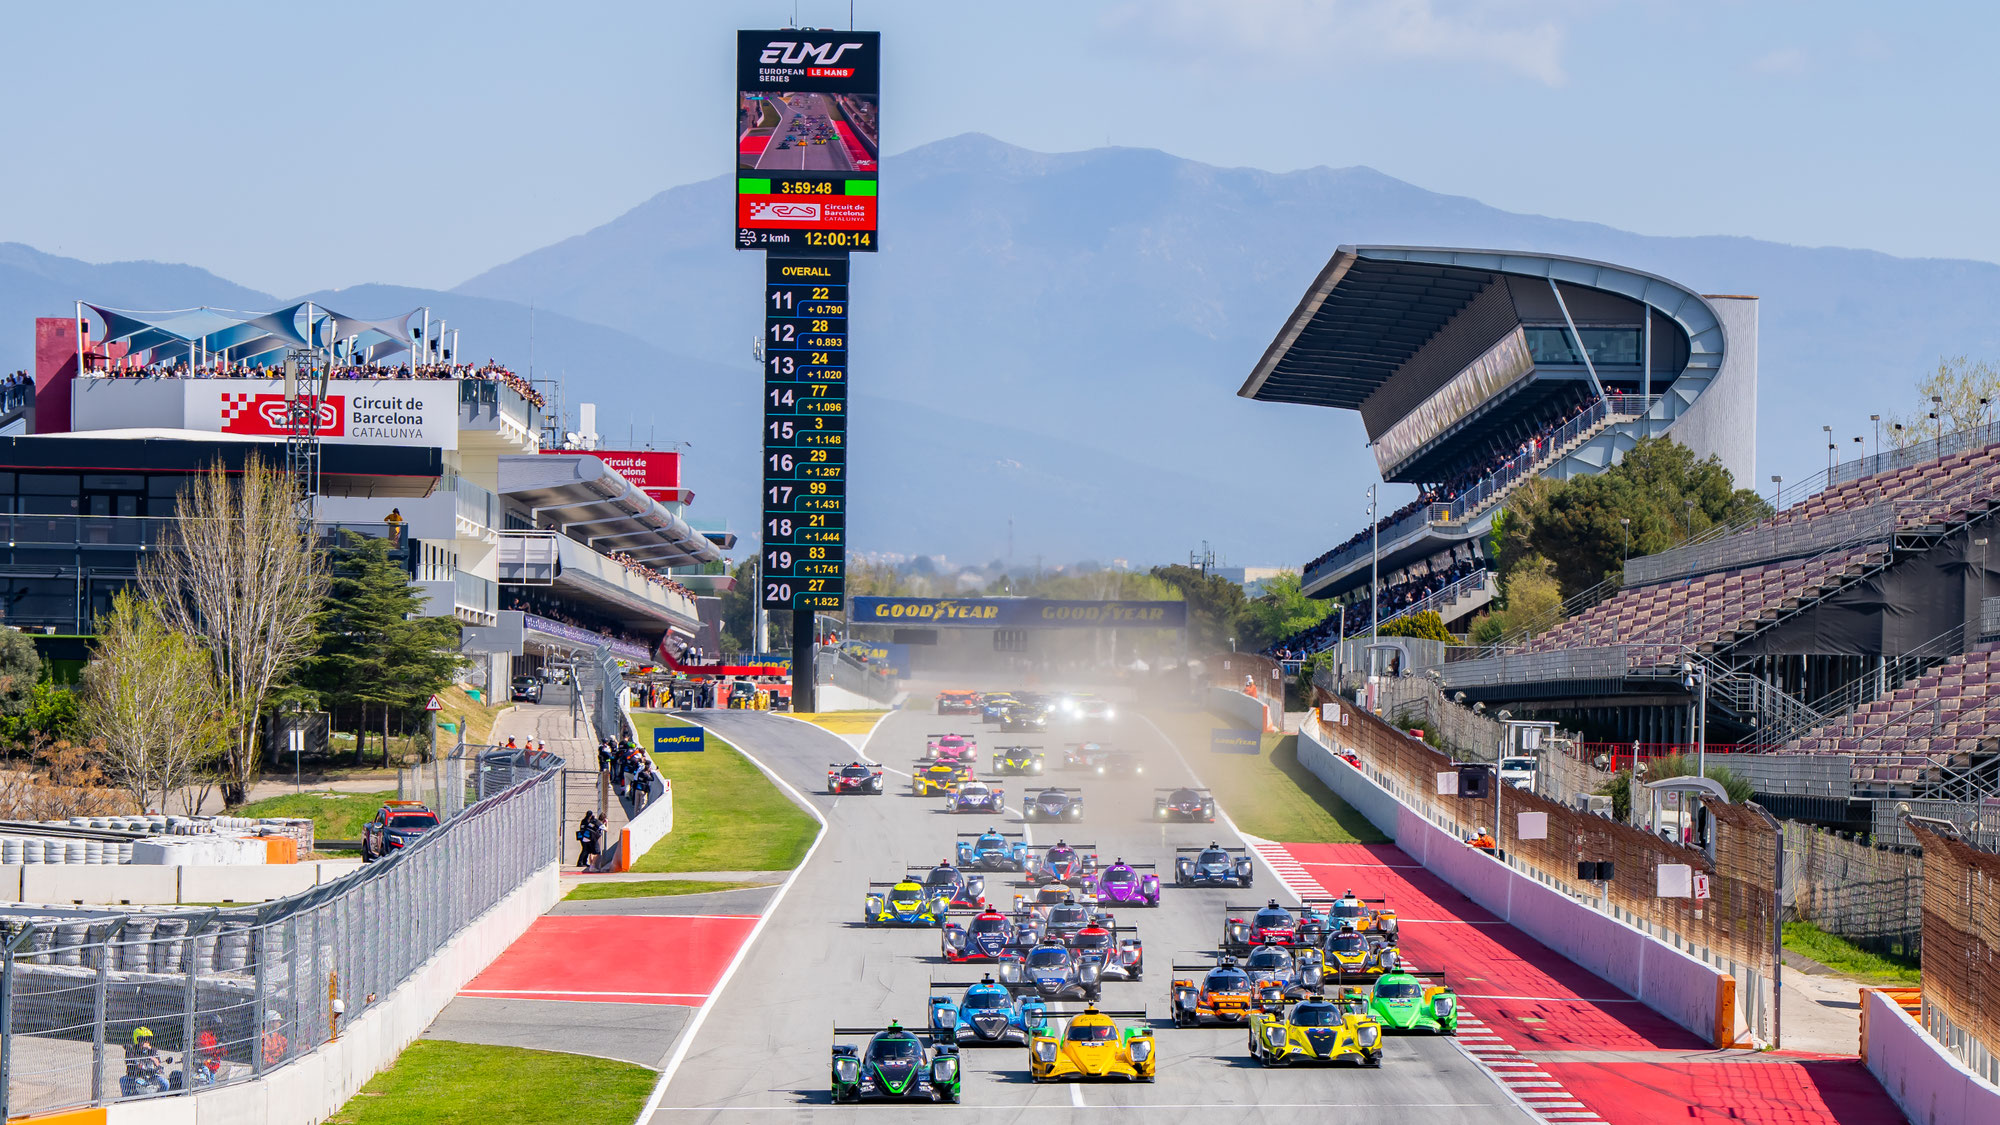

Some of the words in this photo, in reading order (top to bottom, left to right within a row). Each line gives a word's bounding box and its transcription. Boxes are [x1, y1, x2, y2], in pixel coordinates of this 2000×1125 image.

[759, 67, 805, 76] EUROPEAN
[823, 69, 848, 77] MANS
[759, 75, 790, 83] SERIES
[781, 181, 832, 195] 3:59:48
[824, 203, 852, 211] Circuit
[760, 233, 768, 243] 2
[769, 233, 790, 243] kmh
[804, 231, 871, 247] 12:00:14
[781, 266, 831, 277] OVERALL
[812, 287, 829, 300] 22
[771, 291, 792, 310] 11
[816, 305, 843, 315] 0.790
[811, 319, 829, 332] 28
[770, 323, 795, 342] 12
[816, 337, 843, 347] 0.893
[811, 352, 829, 365] 24
[770, 356, 795, 375] 13
[816, 370, 842, 380] 1.020
[811, 384, 828, 397] 77
[352, 396, 403, 410] Circuit
[405, 397, 424, 411] de
[770, 388, 794, 407] 14
[815, 402, 842, 412] 1.096
[353, 411, 424, 425] Barcelona
[815, 417, 824, 430] 3
[351, 427, 424, 439] CATALUNYA
[769, 421, 794, 440] 15
[815, 435, 842, 445] 1.148
[810, 449, 827, 462] 29
[634, 458, 647, 467] de
[769, 453, 793, 472] 16
[815, 467, 841, 477] 1.267
[768, 486, 793, 504] 17
[809, 482, 827, 495] 99
[814, 499, 840, 509] 1.431
[809, 514, 825, 527] 21
[768, 518, 792, 537] 18
[814, 532, 840, 542] 1.444
[809, 546, 826, 559] 83
[768, 550, 792, 569] 19
[813, 564, 839, 574] 1.741
[808, 579, 825, 592] 27
[766, 583, 791, 602] 20
[813, 597, 839, 607] 1.822
[875, 601, 999, 622] GOODYEAR
[1041, 603, 1165, 622] GOODYEAR
[657, 735, 701, 744] GOODYEAR
